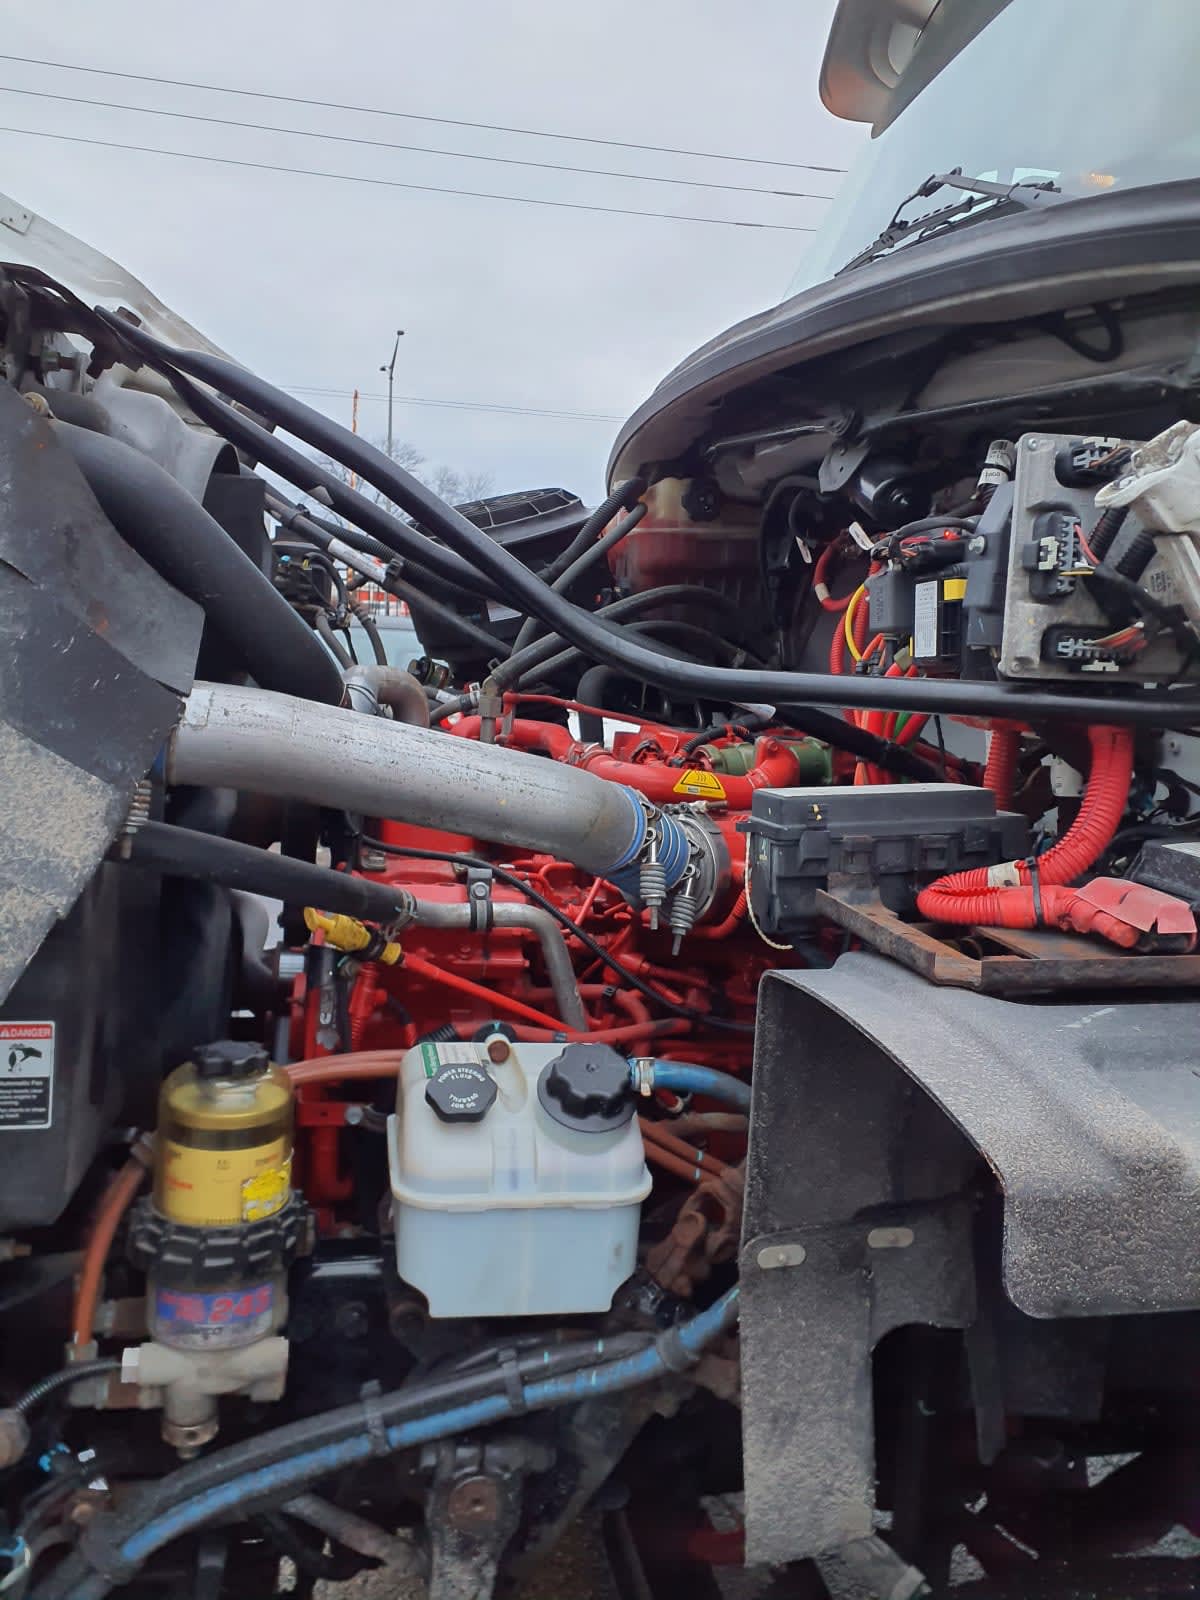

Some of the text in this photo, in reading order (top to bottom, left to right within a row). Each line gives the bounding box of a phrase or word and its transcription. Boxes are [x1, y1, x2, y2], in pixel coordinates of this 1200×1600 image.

[10, 1027, 51, 1038] DANGER
[438, 1068, 485, 1083] POWER STEERING
[449, 1093, 479, 1103] OVERFILL
